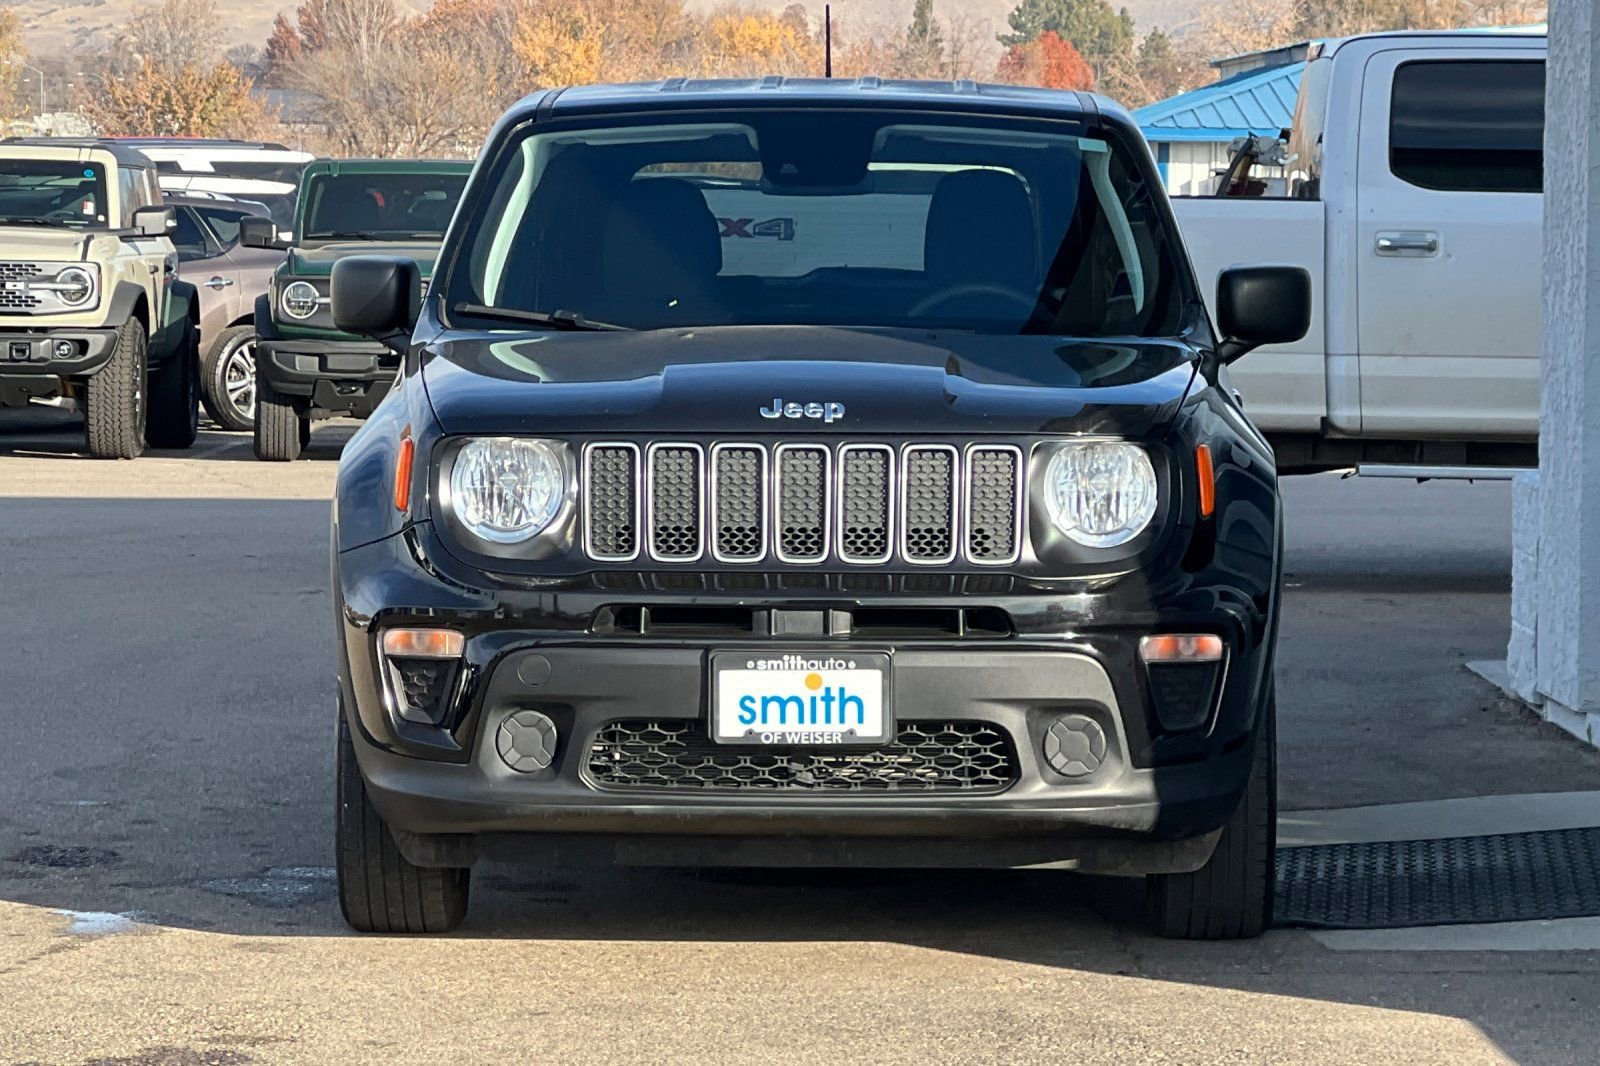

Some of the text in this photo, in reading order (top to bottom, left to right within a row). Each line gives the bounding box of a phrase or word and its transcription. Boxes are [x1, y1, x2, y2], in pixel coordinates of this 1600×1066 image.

[716, 217, 795, 241] X4
[760, 398, 845, 423] Jeep
[756, 655, 846, 671] smithauto
[738, 673, 864, 725] smith
[760, 732, 842, 744] OF WEISER
